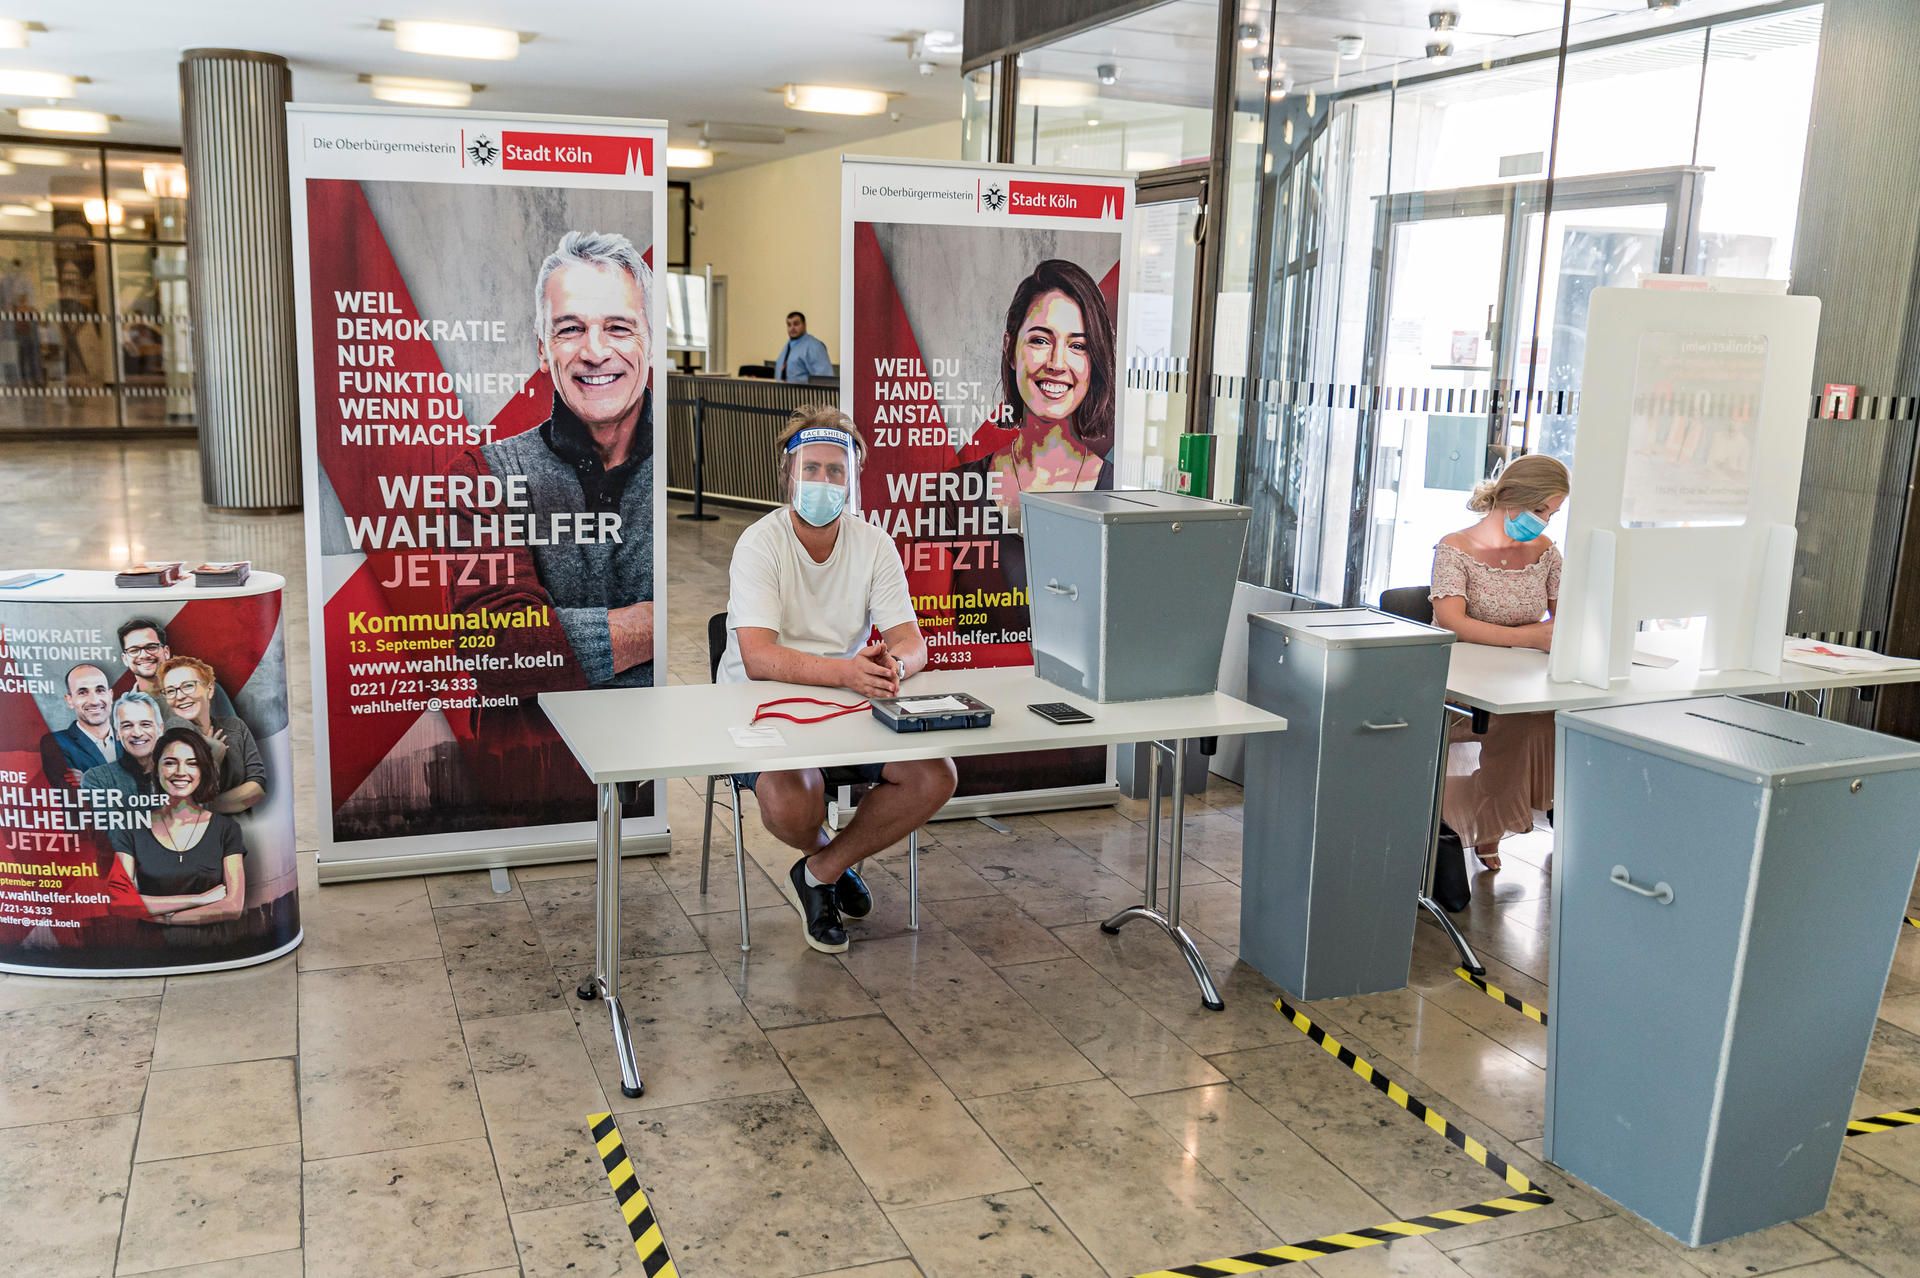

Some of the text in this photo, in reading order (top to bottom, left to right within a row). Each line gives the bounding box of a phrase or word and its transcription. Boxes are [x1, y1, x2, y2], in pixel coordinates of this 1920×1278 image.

[313, 137, 456, 154] Die Oberbürgermeisterin
[506, 144, 593, 163] Stadt Köln
[862, 185, 974, 201] Die Oberbürgermeisterin
[1012, 192, 1078, 209] Stadt Köln
[334, 291, 402, 314] WEIL
[337, 318, 506, 342] DEMOKRATIE
[338, 345, 395, 367] NUR
[874, 358, 960, 378] WEIL DU
[338, 371, 535, 398] FUNKTIONIERT,
[875, 381, 986, 404] HANDELST,
[338, 398, 463, 420] WENN DU
[874, 404, 1014, 424] ANSTATT NUR
[341, 424, 502, 446] MITMACHST.
[803, 430, 847, 440] FACE SHIELD
[874, 428, 979, 447] ZU REDEN.
[378, 475, 528, 509] WERDE
[886, 472, 1004, 503] WERDE
[344, 512, 623, 549] WAHLHELFER
[860, 506, 1024, 538] WAHLHEL
[381, 552, 515, 588] JETZT!
[349, 605, 550, 634] Kommunalwahl
[917, 613, 987, 628] ember 2020
[0, 627, 102, 643] EMOKRATIE
[350, 635, 496, 654] 13. September 2020
[4, 662, 43, 677] ALLE
[349, 651, 564, 676] www.wahlhelfer.koeln
[350, 694, 519, 714] wahlhelfer@stadt.koeln
[0, 771, 27, 784] RDE
[0, 786, 170, 808] HLHELFER ODER
[0, 808, 152, 831] HLHELFERIN
[6, 831, 80, 853] JETZT!
[0, 878, 63, 888] ptember 2020
